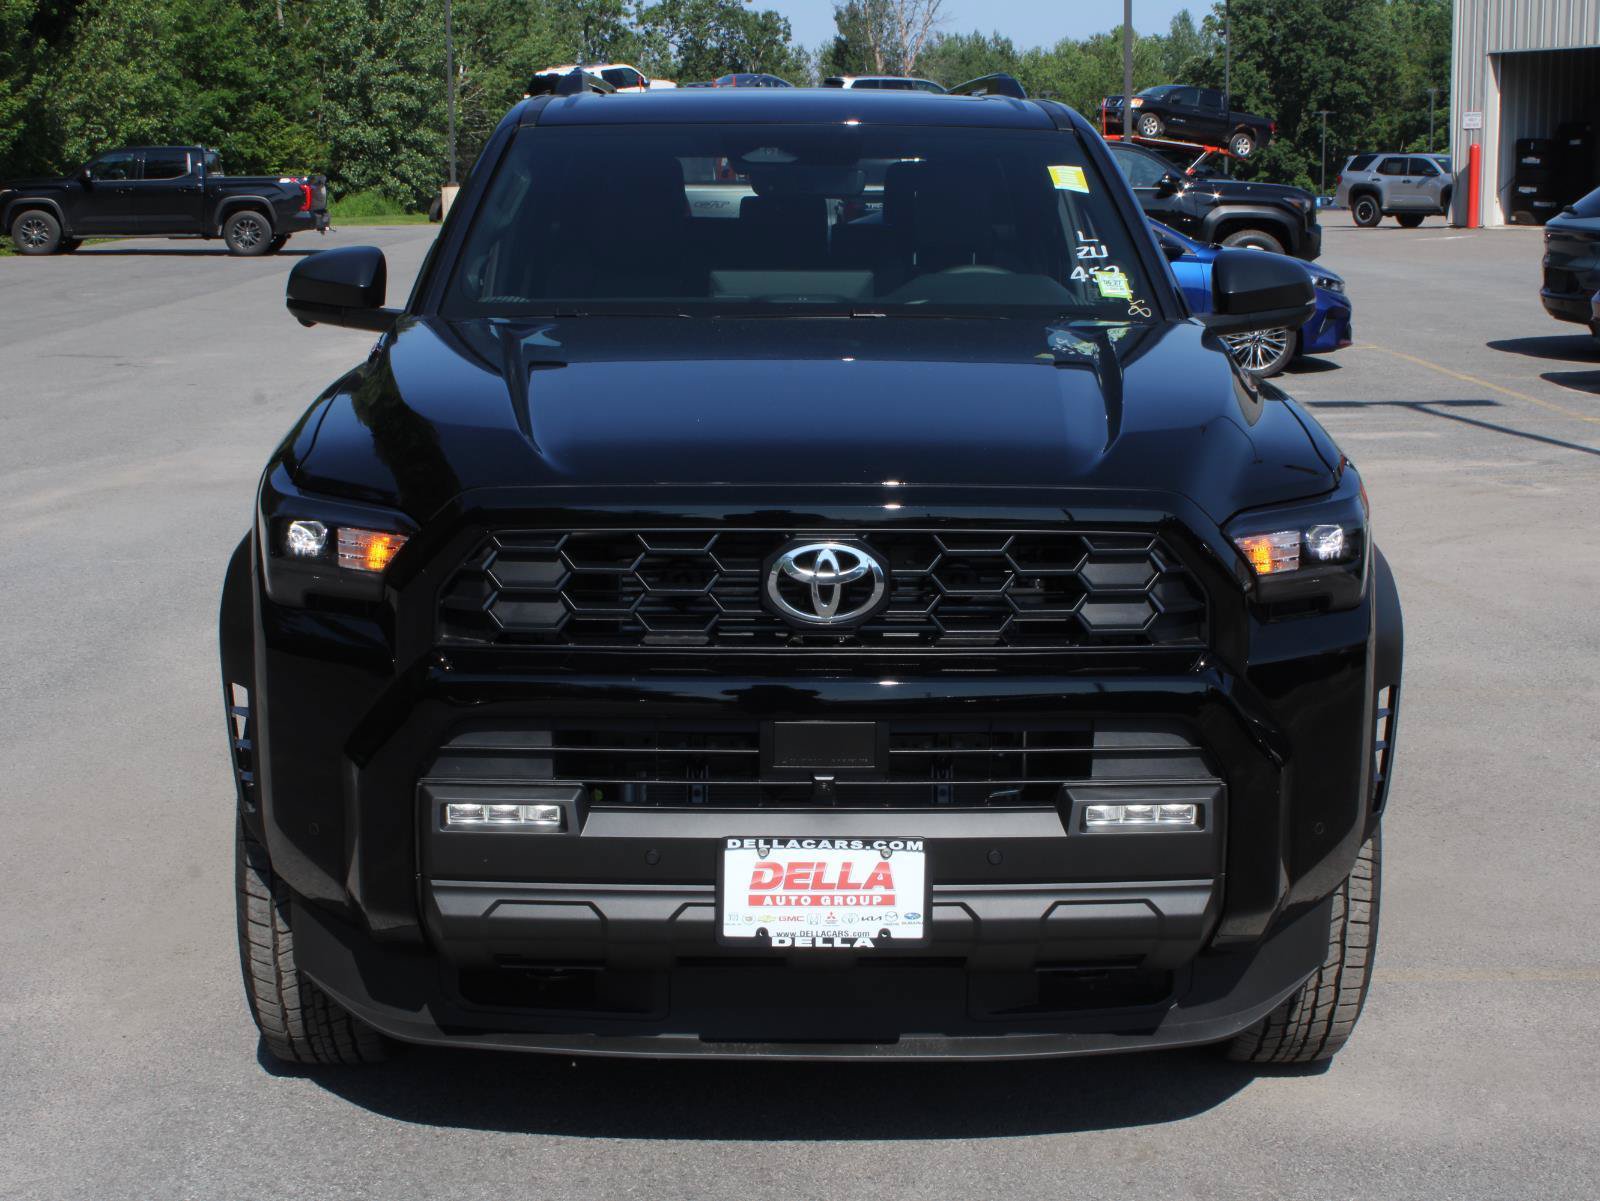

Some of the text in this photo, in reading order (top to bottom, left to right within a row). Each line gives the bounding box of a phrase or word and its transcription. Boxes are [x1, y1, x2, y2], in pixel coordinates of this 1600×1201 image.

[726, 839, 924, 851] DELLACARS.COM
[749, 861, 895, 890] DELLA
[762, 895, 884, 906] AUTO GROUP
[771, 936, 875, 948] DELLA
